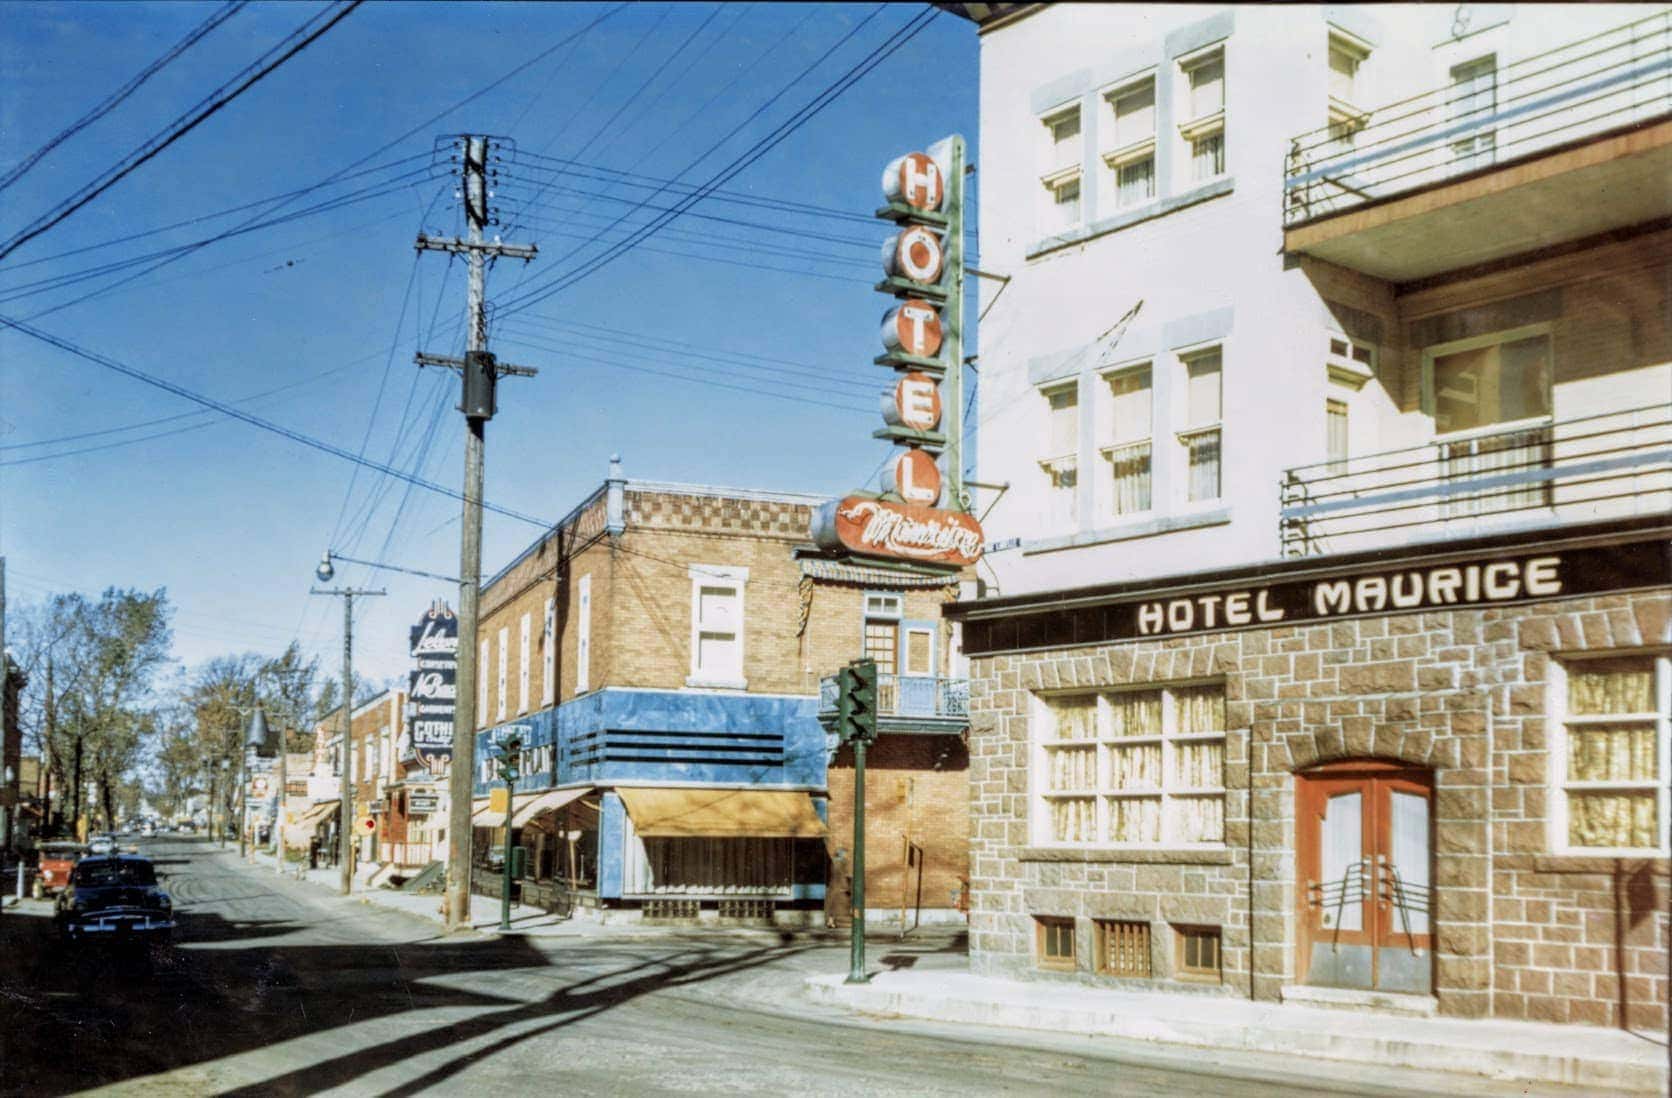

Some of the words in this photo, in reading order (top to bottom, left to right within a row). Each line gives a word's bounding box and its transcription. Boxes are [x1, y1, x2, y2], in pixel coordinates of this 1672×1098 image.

[902, 157, 940, 500] HOTEL
[1137, 590, 1285, 635] HOTEL
[1313, 557, 1563, 616] MAURICE
